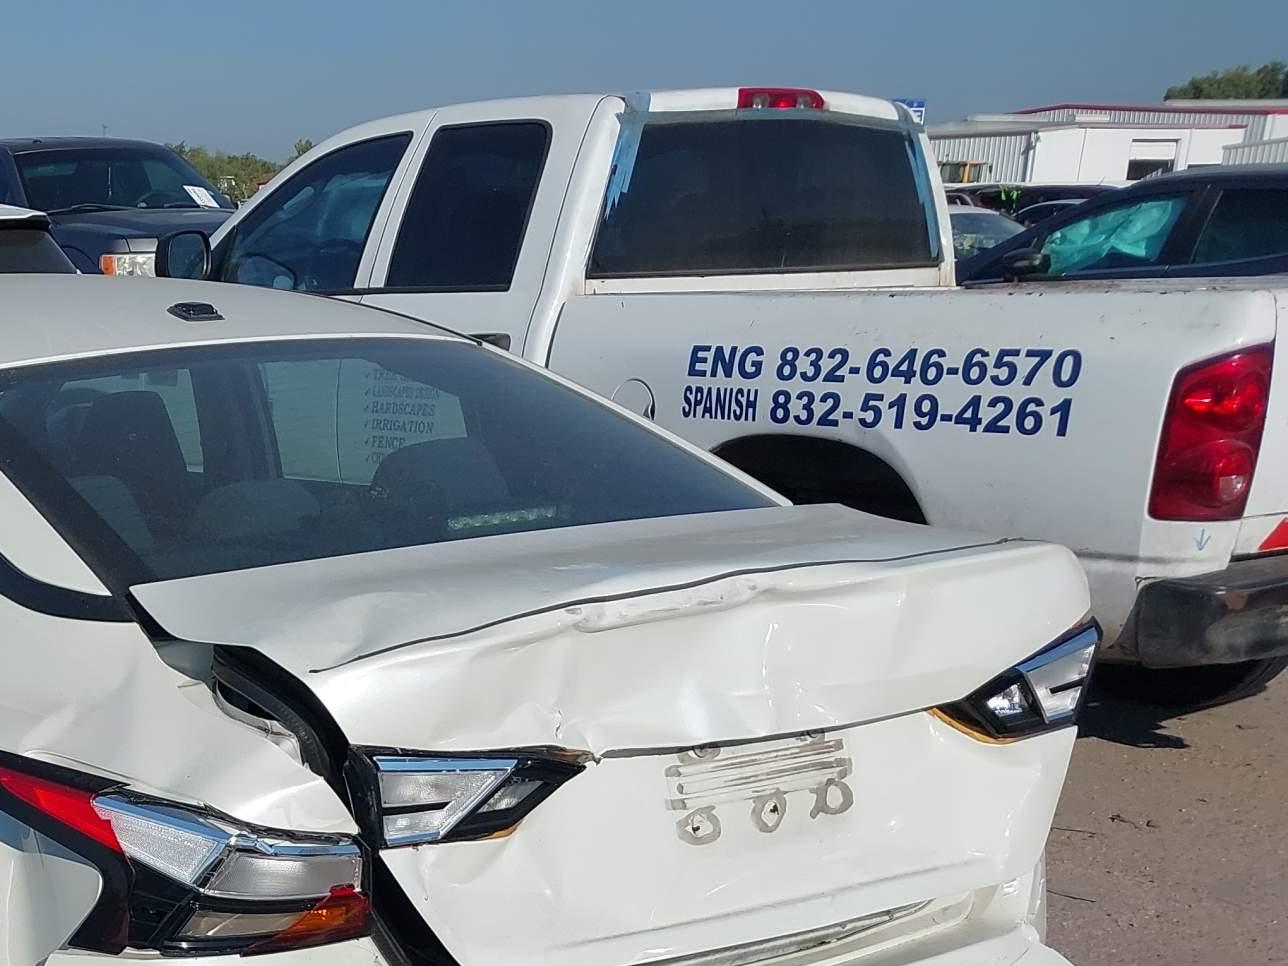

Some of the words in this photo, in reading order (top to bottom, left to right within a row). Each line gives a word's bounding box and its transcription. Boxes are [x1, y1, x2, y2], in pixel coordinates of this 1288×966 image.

[687, 345, 763, 380] ENG
[775, 347, 1082, 390] 832-646-6570
[371, 401, 436, 416] HARDSCAPES
[682, 384, 758, 422] SPANISH
[770, 390, 1074, 436] 832-519-4261
[371, 418, 434, 434] IRRIGATION
